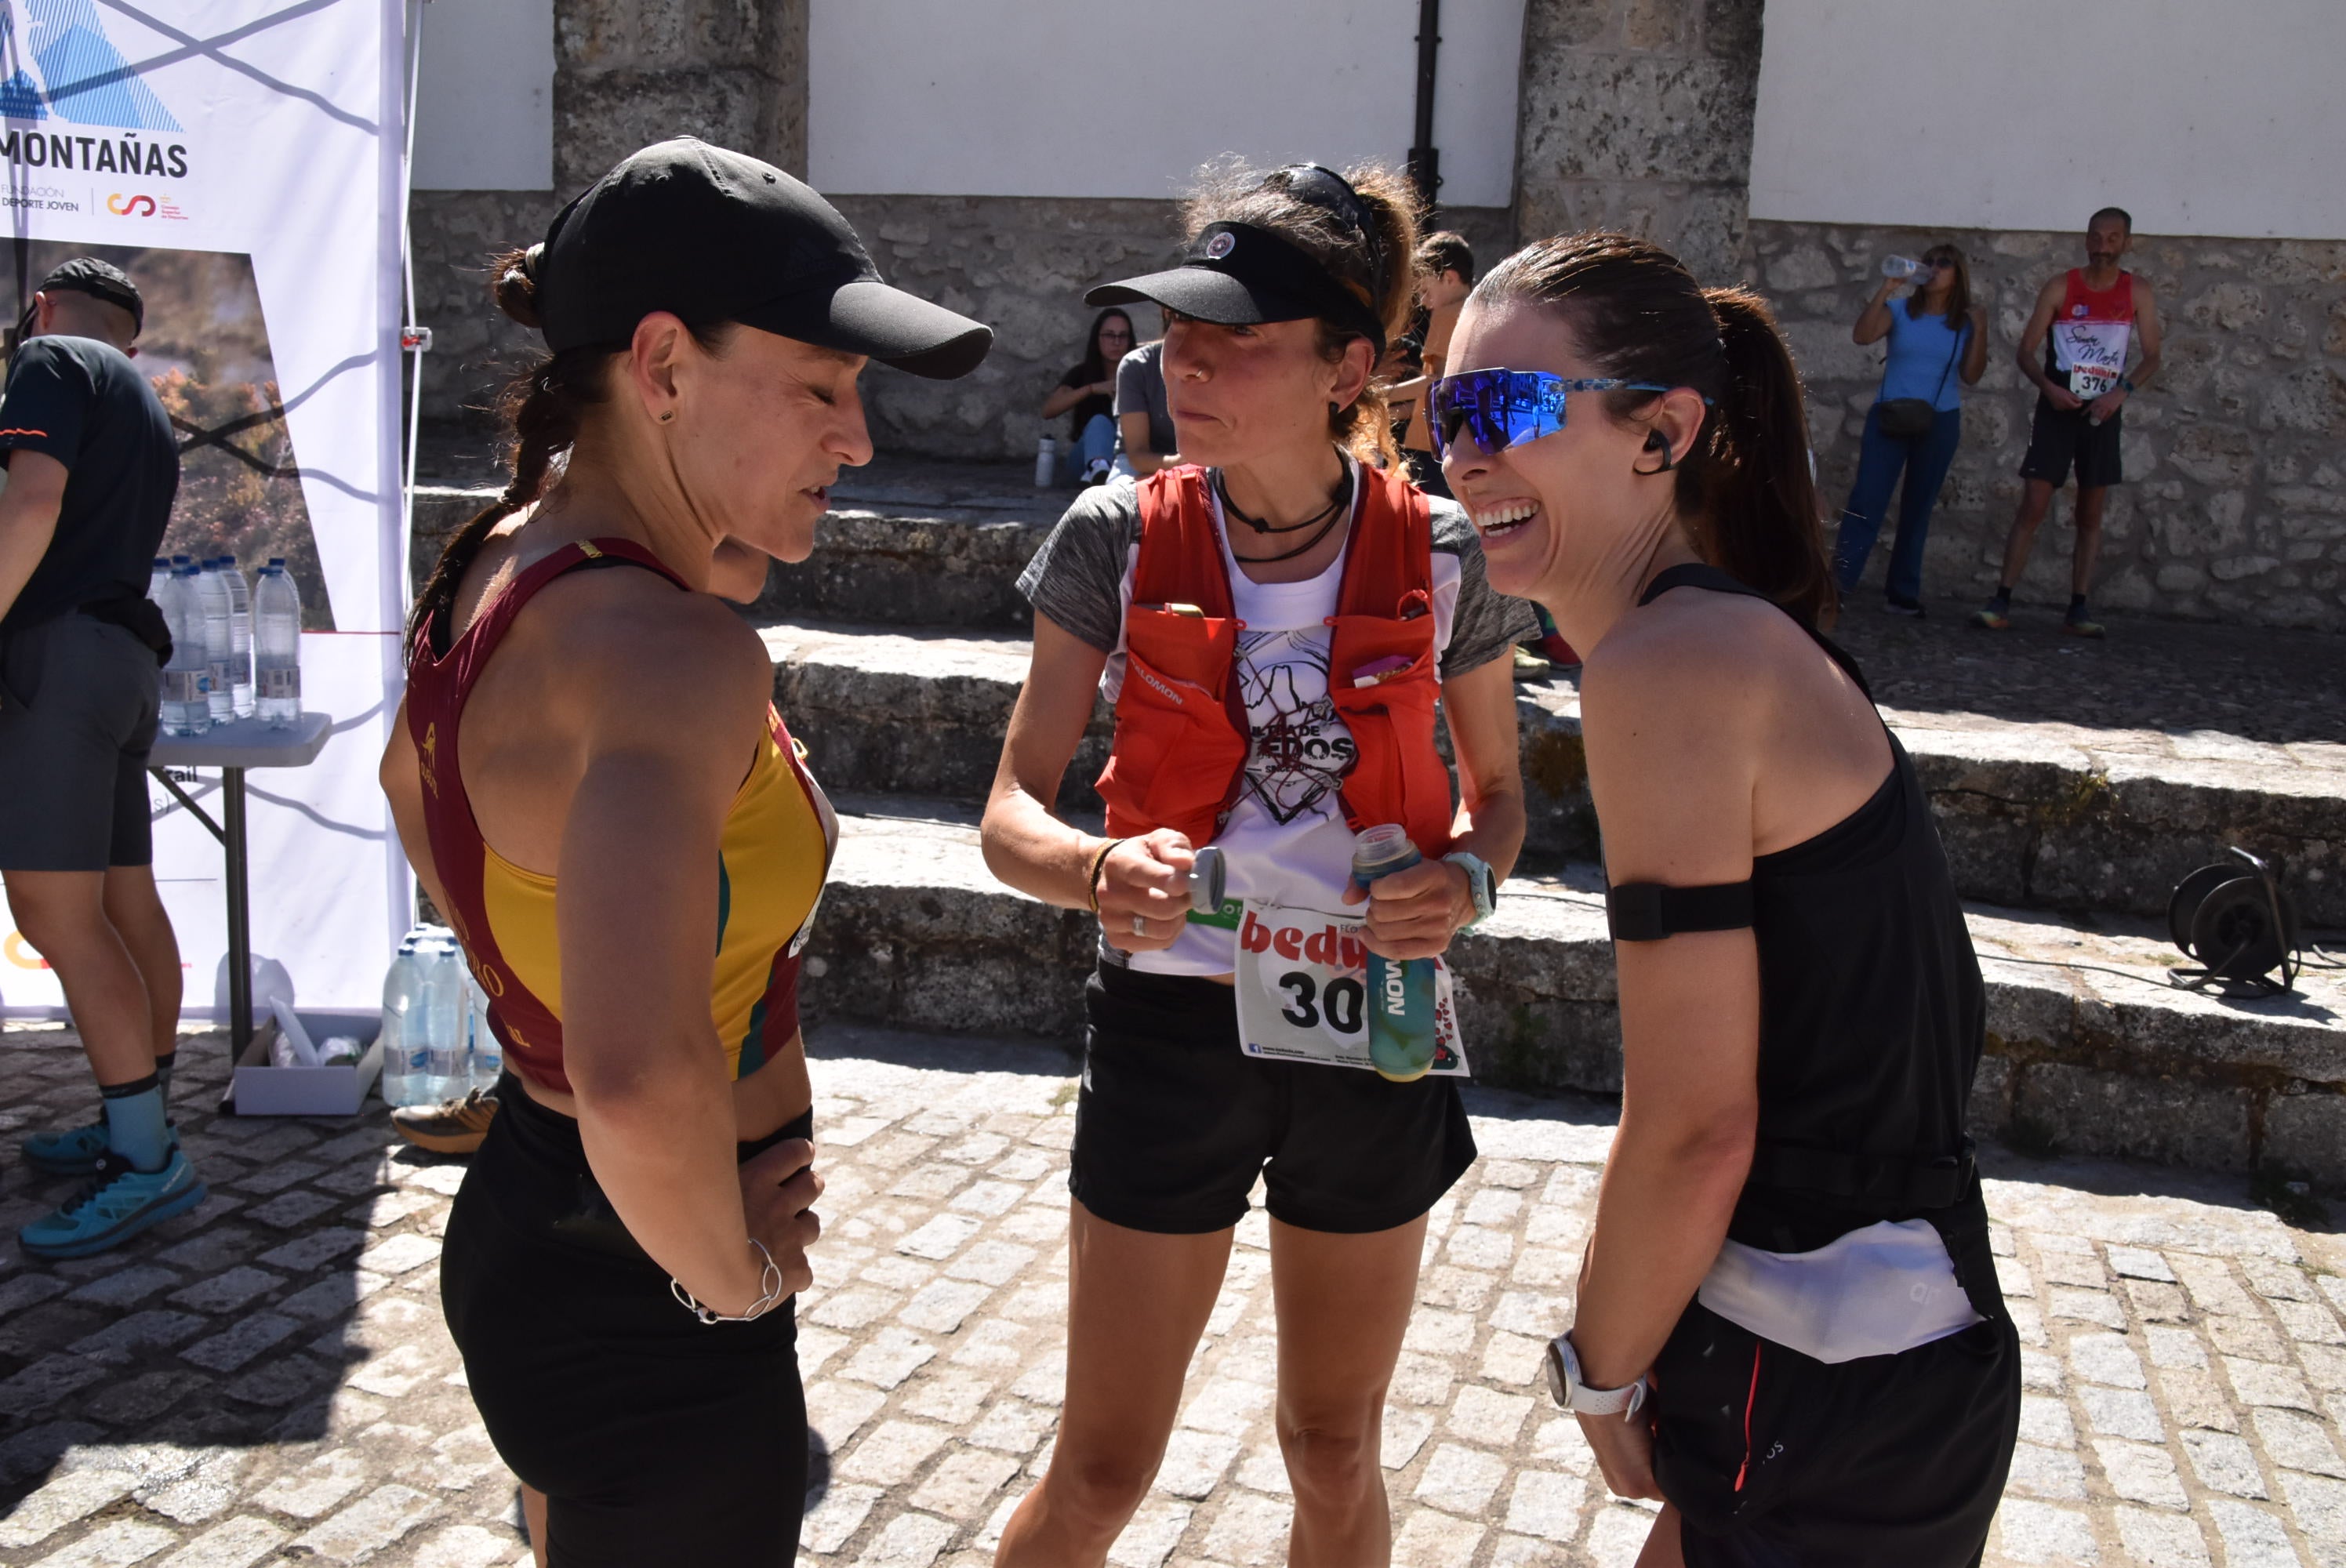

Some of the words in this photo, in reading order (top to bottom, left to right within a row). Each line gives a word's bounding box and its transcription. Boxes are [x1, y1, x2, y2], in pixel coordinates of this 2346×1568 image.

[0, 130, 187, 178] MONTAÑAS
[2, 184, 64, 198] FUNDACIÓN
[2, 198, 43, 209] DEPORTE
[46, 201, 78, 212] JOVEN
[2082, 376, 2108, 393] 376
[1340, 924, 1359, 934] FLO
[1240, 910, 1368, 969] bedu
